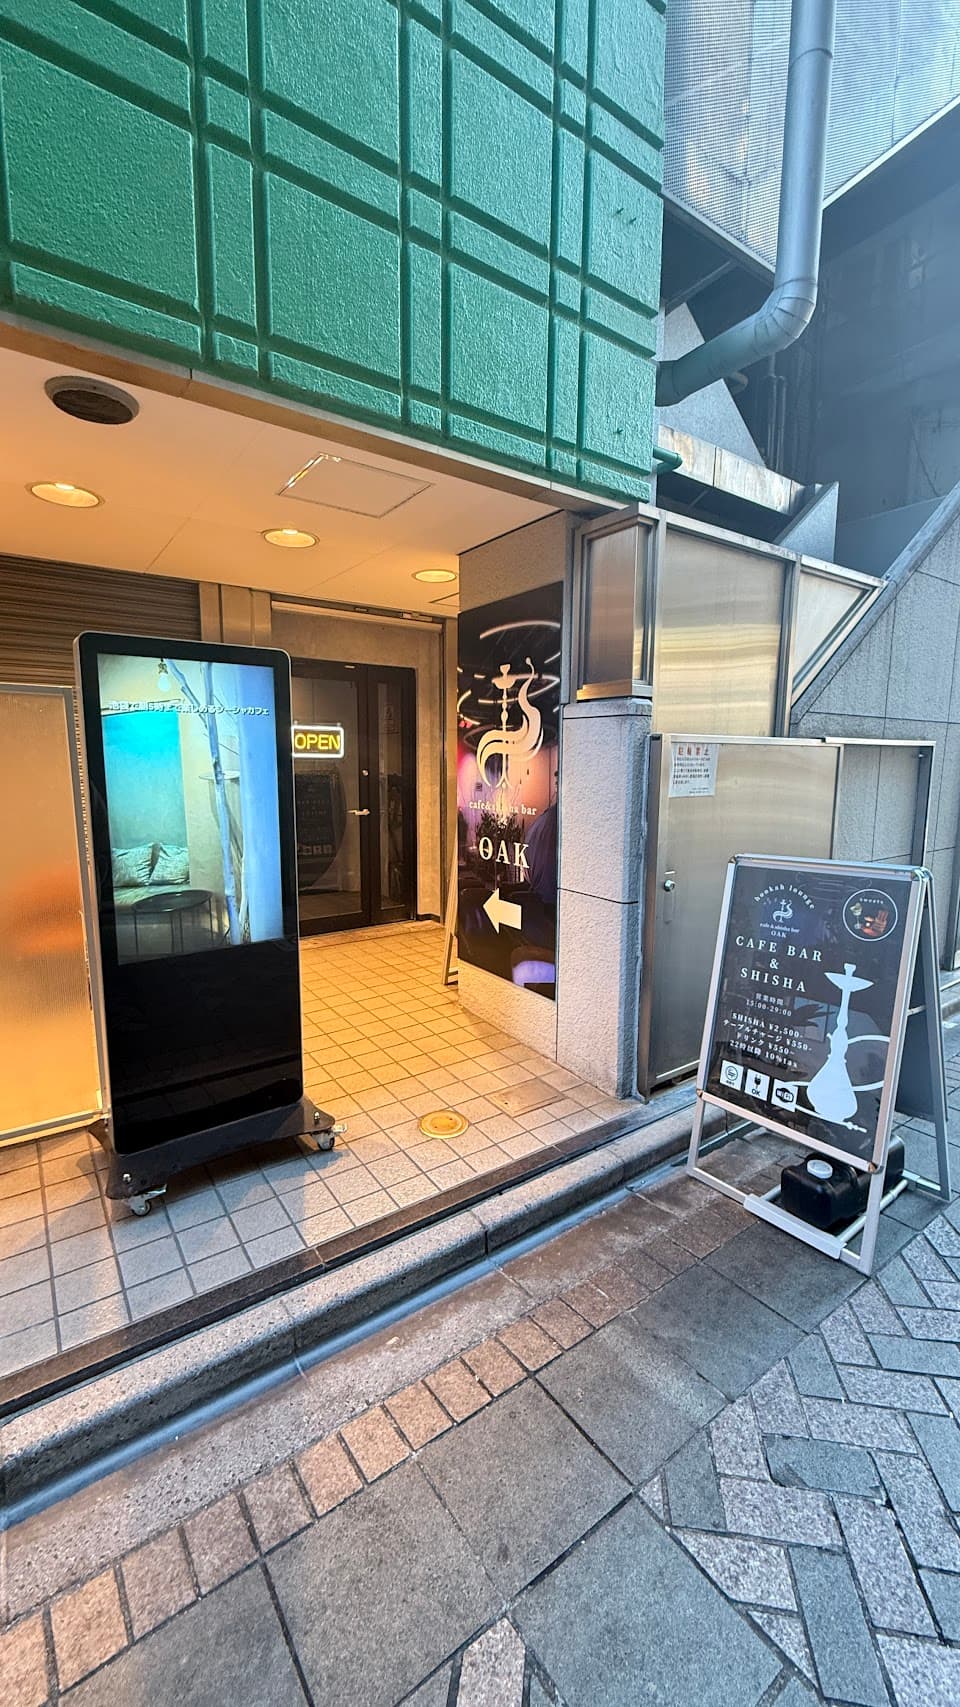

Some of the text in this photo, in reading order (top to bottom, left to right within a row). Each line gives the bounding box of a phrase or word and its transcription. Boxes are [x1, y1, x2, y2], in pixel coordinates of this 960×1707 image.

[294, 733, 341, 750] OPEN
[521, 803, 537, 815] bar
[478, 836, 530, 869] OAK
[771, 930, 787, 938] OAK
[735, 935, 822, 962] CAFE BAR
[769, 958, 780, 970] &
[740, 967, 806, 993] SHISHA
[732, 1012, 765, 1028] SHISHA
[723, 1019, 783, 1042] テーブルチャージ
[736, 1032, 764, 1046] ドリンク
[729, 1039, 761, 1056] 22時以降
[751, 1088, 761, 1097] OK
